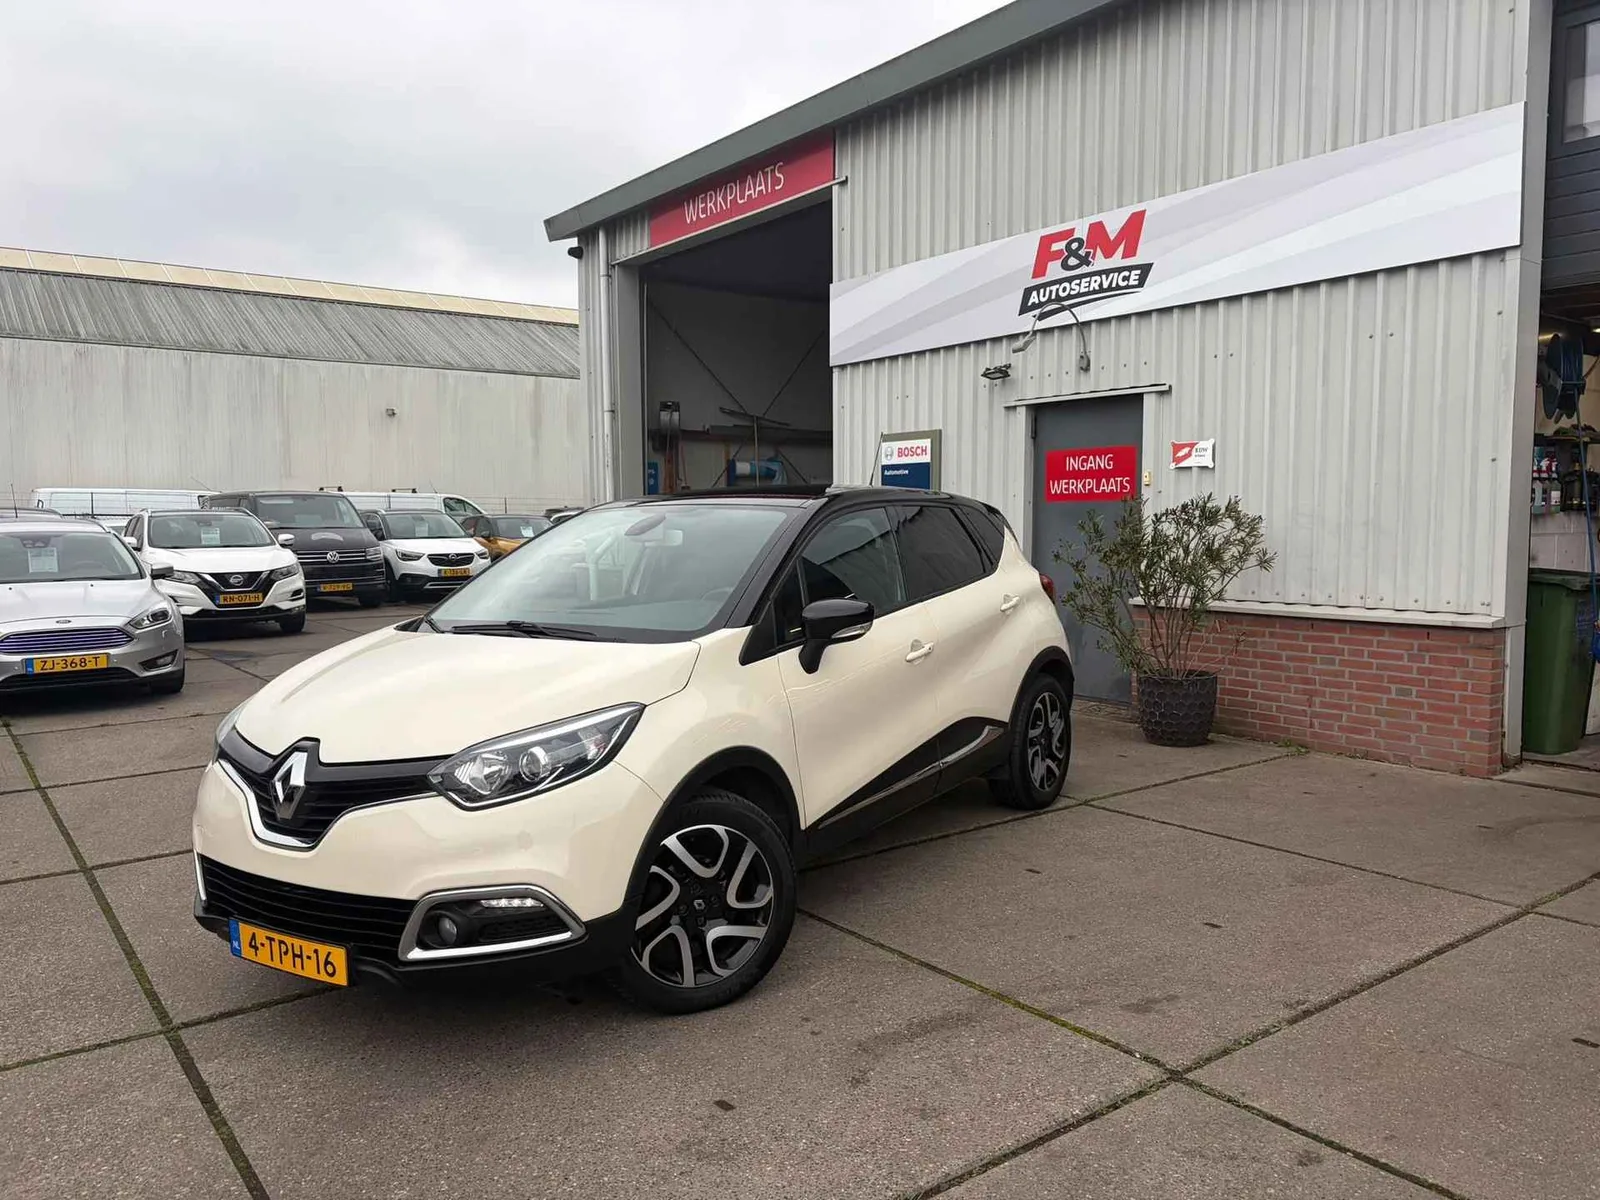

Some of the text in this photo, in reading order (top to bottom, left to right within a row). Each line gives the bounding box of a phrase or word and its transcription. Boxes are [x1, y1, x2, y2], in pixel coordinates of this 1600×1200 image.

[683, 161, 785, 225] WERKPLAATS
[1031, 209, 1147, 280] F&M
[1027, 269, 1141, 307] AUTOSERVICE
[897, 445, 928, 458] BOSCH
[1065, 453, 1114, 472] INGANG
[1049, 477, 1131, 495] WERKPLAATS
[223, 594, 260, 603] RN-071-H
[40, 656, 100, 671] ZJ-368-T
[248, 931, 337, 978] 4-TPH-16
